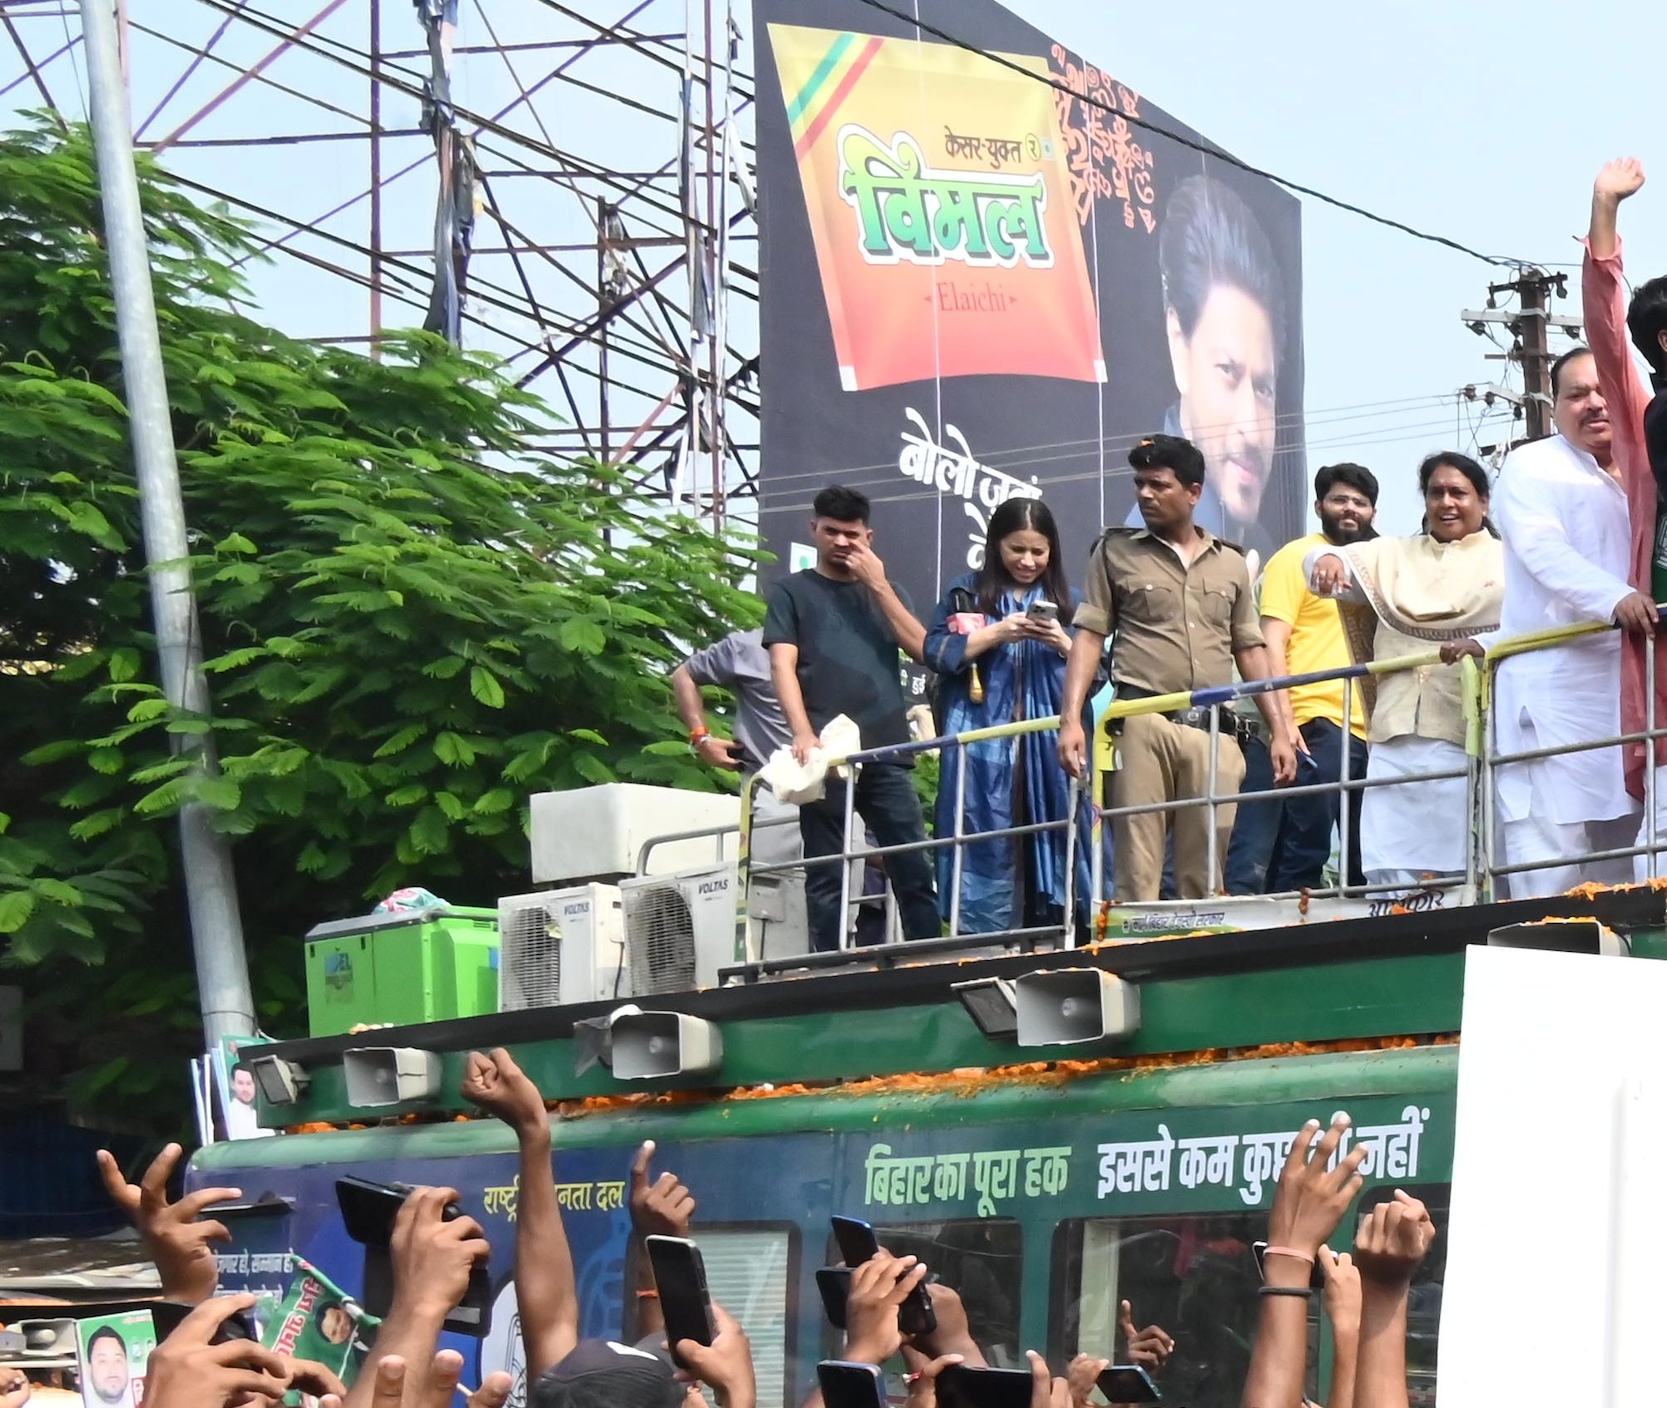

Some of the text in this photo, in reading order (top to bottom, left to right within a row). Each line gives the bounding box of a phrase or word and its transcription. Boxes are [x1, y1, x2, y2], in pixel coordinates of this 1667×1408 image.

[838, 125, 1054, 267] विमल
[937, 280, 1007, 314] Elaichi
[898, 407, 980, 499] बोलो
[698, 879, 729, 895] VOLTAS
[596, 1180, 626, 1212] दल
[864, 1143, 933, 1206] बिहार
[933, 1147, 968, 1202] का
[972, 1148, 1018, 1218] पूरा
[1023, 1144, 1072, 1199] हक
[1097, 1123, 1176, 1200] इससे
[1178, 1135, 1240, 1189] कम
